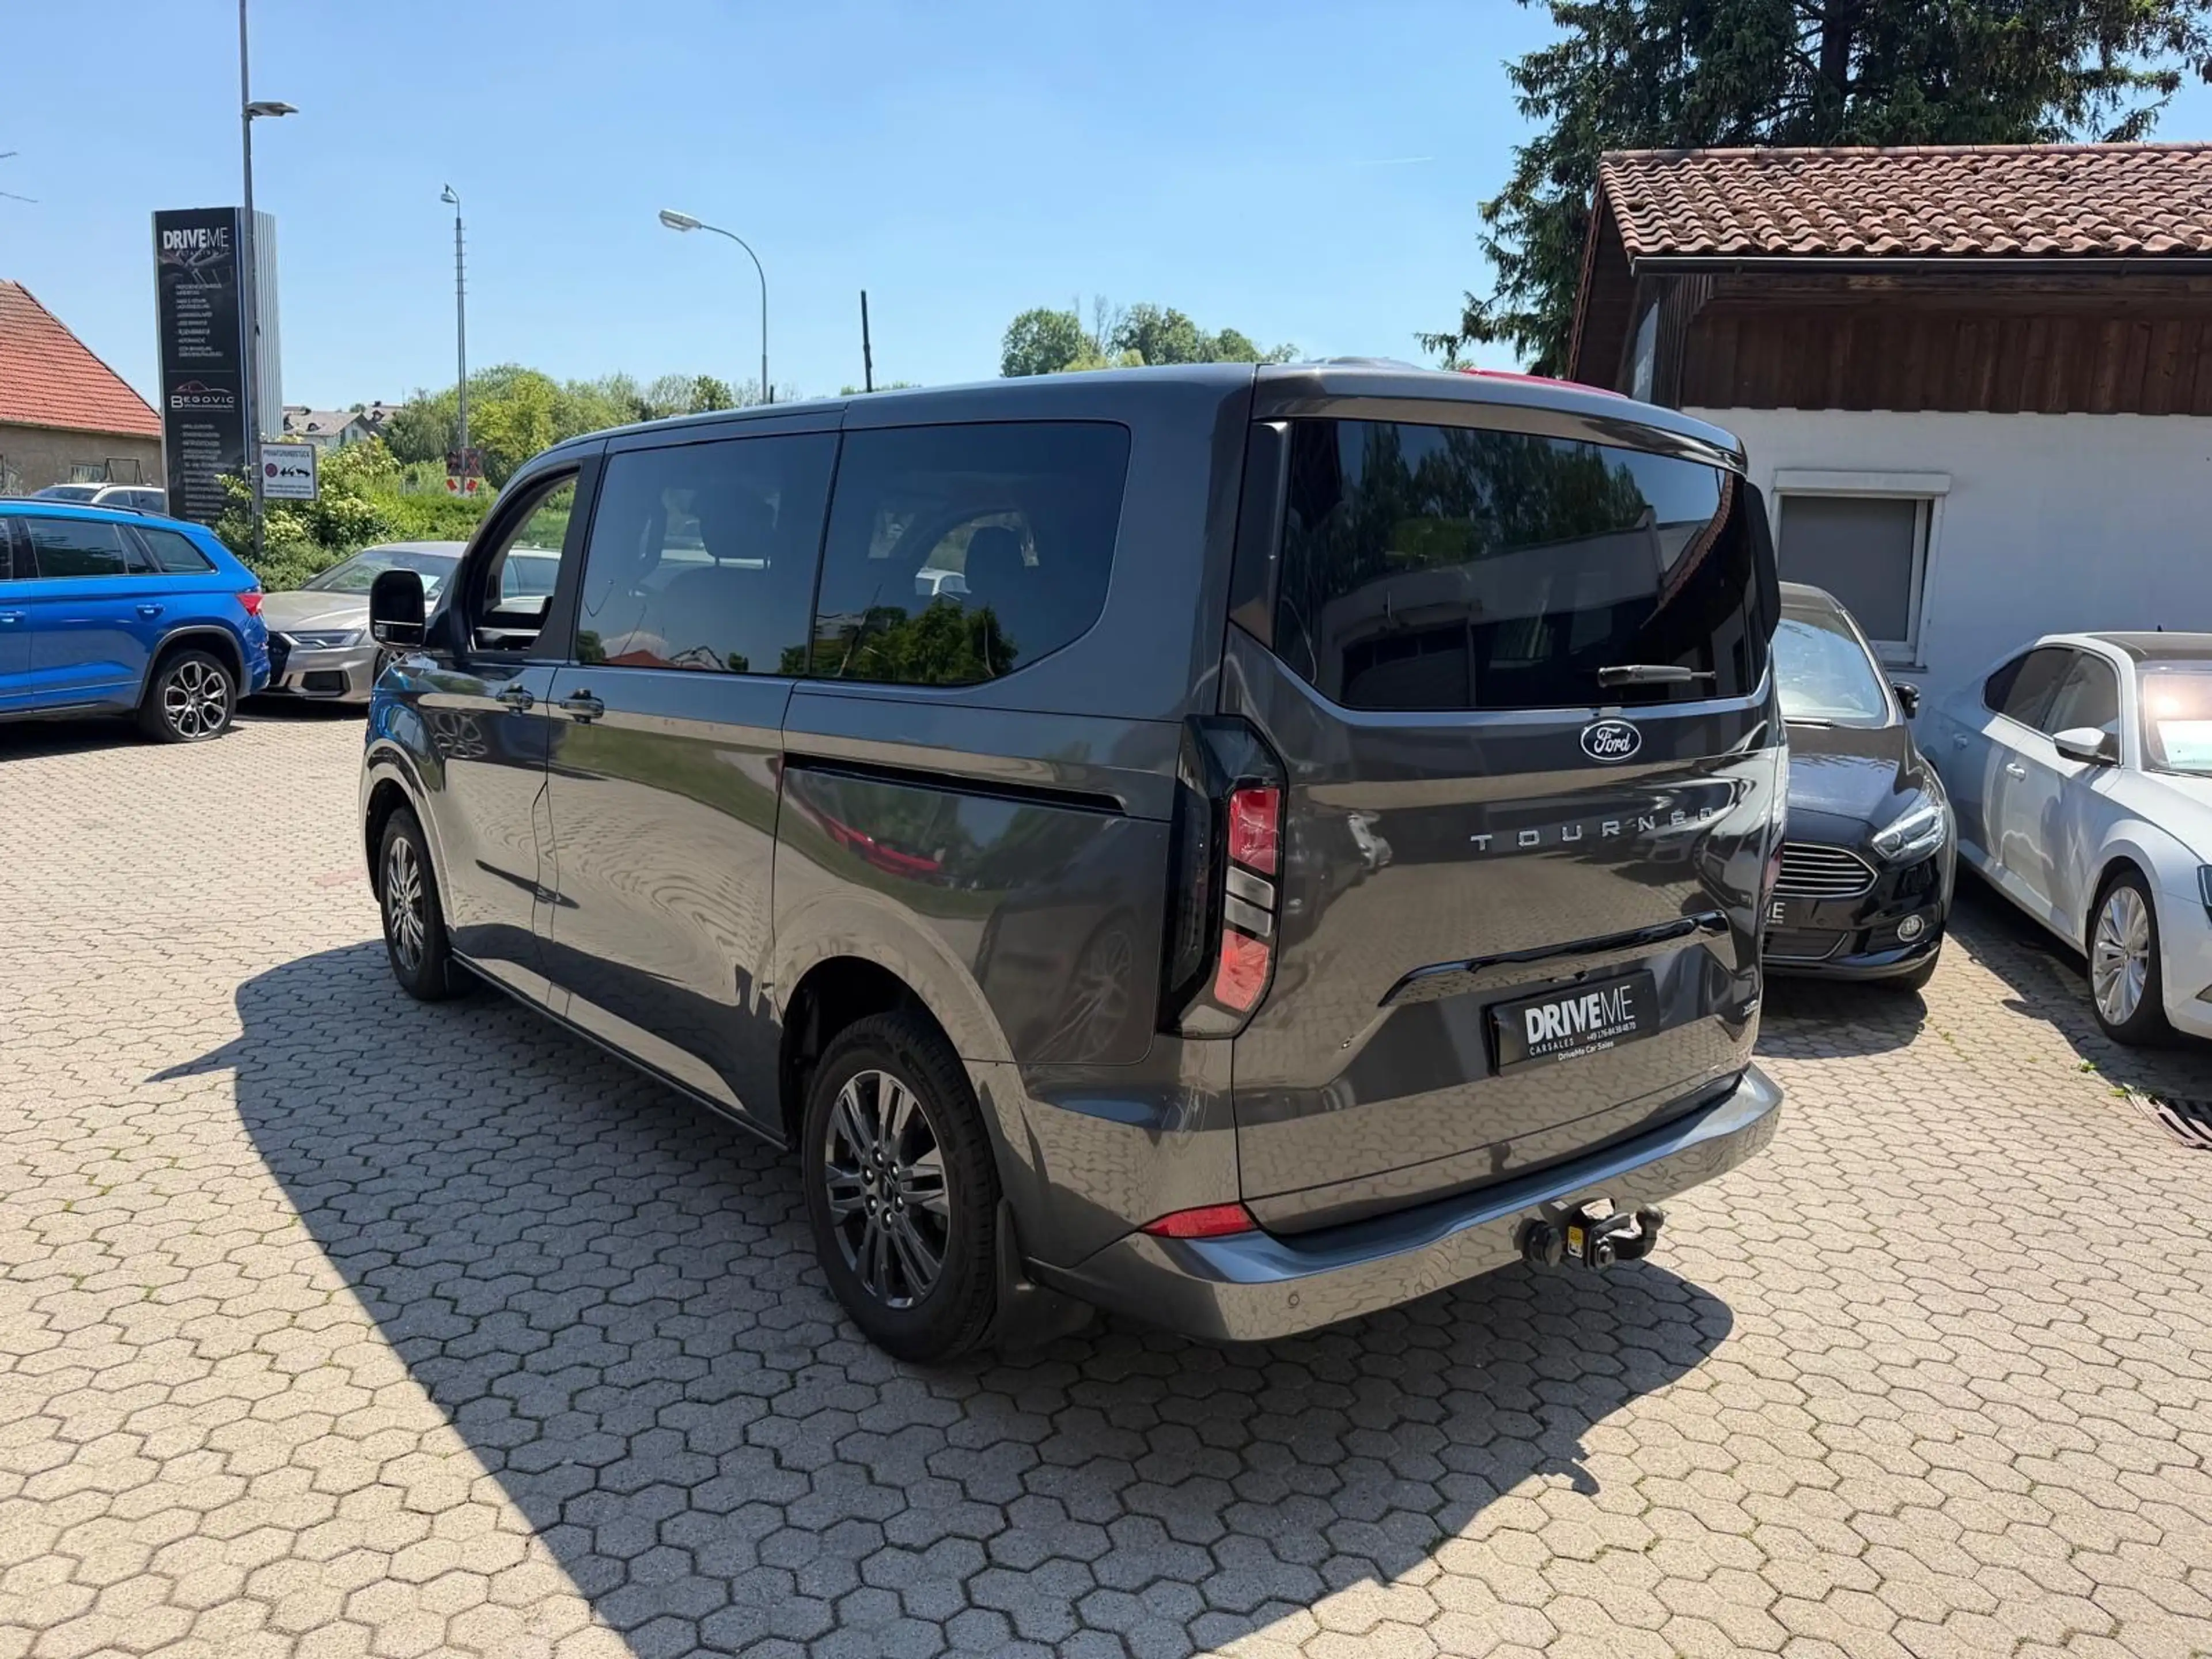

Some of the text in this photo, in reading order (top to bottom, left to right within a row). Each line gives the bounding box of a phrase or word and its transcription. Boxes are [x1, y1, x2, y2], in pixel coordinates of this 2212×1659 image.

[163, 227, 229, 249] DRIVEME
[171, 395, 235, 408] BEGOVIC
[1593, 727, 1631, 753] Ford
[1471, 807, 1713, 851] TOURNEO
[1525, 984, 1635, 1044] DRIVEME
[1585, 1044, 1597, 1054] Car
